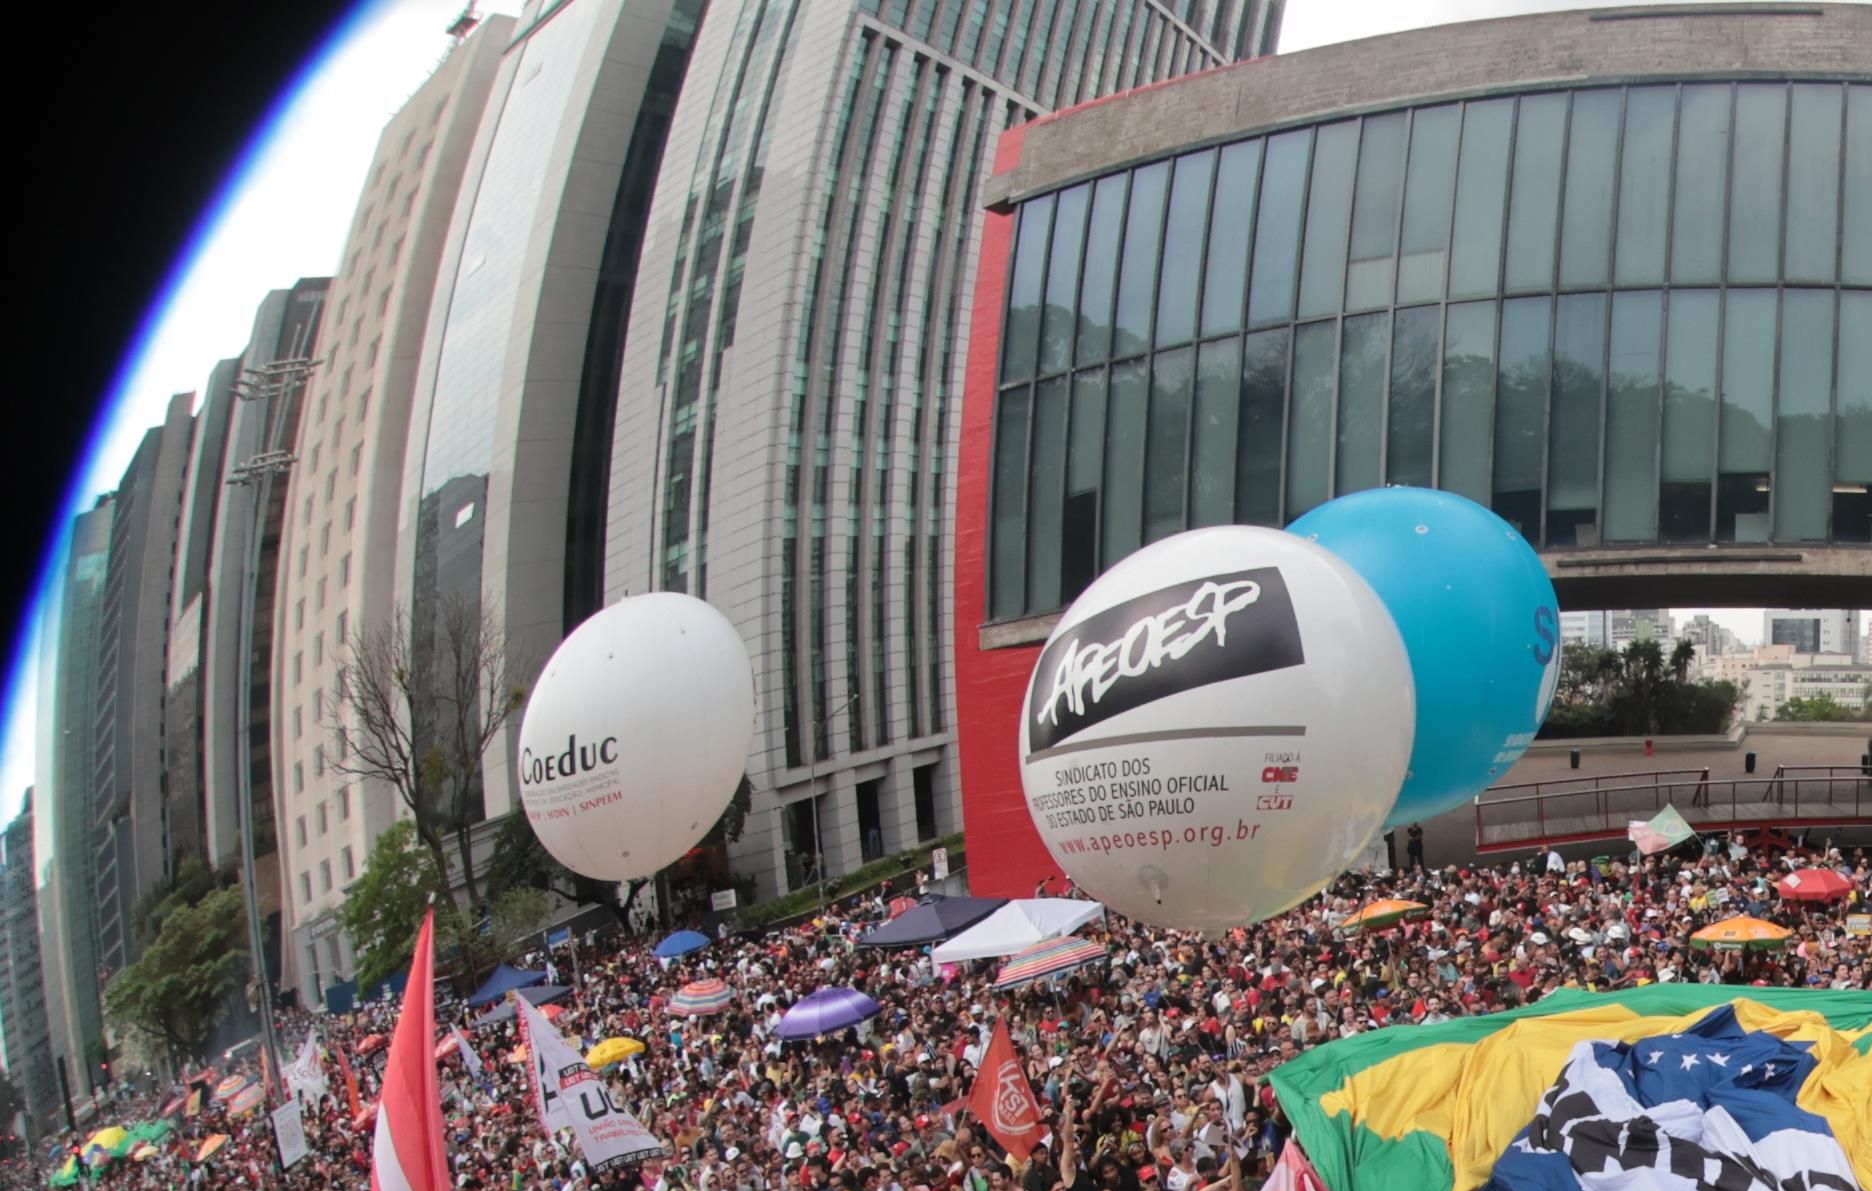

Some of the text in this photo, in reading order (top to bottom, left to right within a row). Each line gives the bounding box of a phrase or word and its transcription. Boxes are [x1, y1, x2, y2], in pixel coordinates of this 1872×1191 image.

[1533, 605, 1561, 667] S
[1037, 581, 1261, 726] APEOESP
[1055, 757, 1151, 787] SINDICATO DOS
[1264, 752, 1294, 764] FILIADO
[1089, 786, 1107, 802] DO
[1111, 778, 1162, 800] ENSINO
[1167, 774, 1230, 794] OFICIAL
[1045, 797, 1195, 829] DO ESTADO DE SÃO PAULO
[1058, 819, 1261, 855] www.apeoesp.org.br
